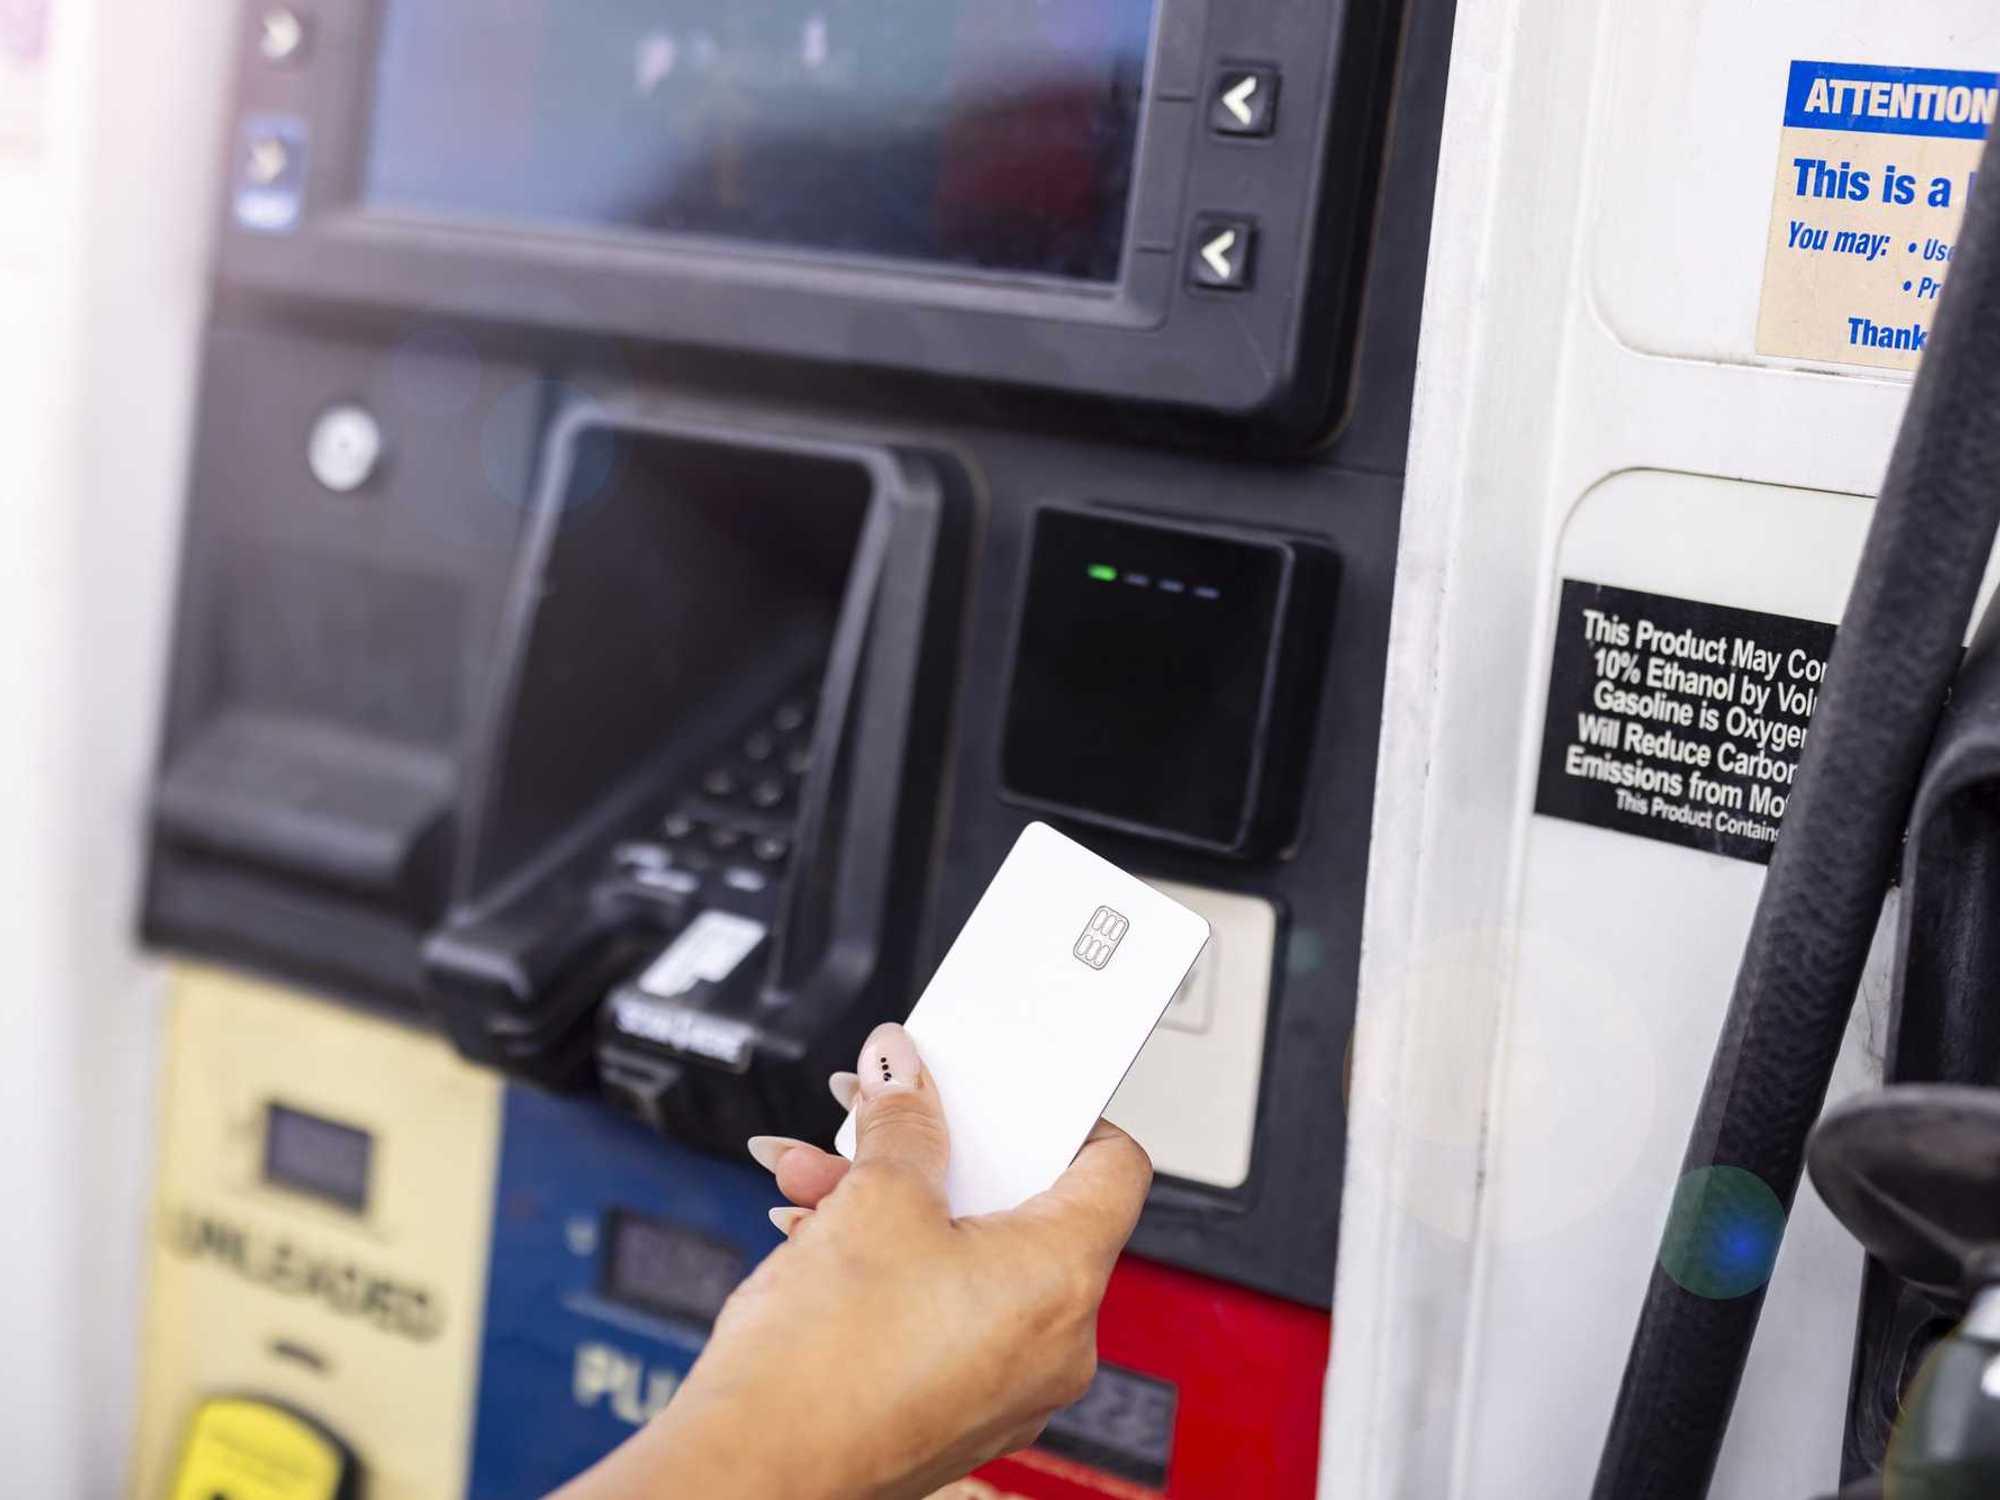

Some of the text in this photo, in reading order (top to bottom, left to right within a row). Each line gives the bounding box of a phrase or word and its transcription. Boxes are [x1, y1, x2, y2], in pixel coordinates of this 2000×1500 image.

[1804, 78, 1998, 124] ATTENTION
[1793, 158, 1870, 202] This
[1882, 165, 1915, 205] is
[1927, 178, 1951, 208] a
[1786, 220, 1891, 261] You may:
[1848, 317, 1928, 351] Thank
[1582, 608, 1630, 646] This
[1635, 618, 1728, 667] Product
[1731, 637, 1781, 681] May
[1593, 681, 1693, 726] Gasoline
[1699, 700, 1719, 732] is
[1594, 647, 1818, 718] 10% Ethanol by Vol
[1577, 712, 1620, 749] Will
[1624, 722, 1712, 768] Reduce
[1565, 744, 1791, 818] Emissions from Mo
[1615, 788, 1649, 815] This
[1651, 796, 1712, 831] Product
